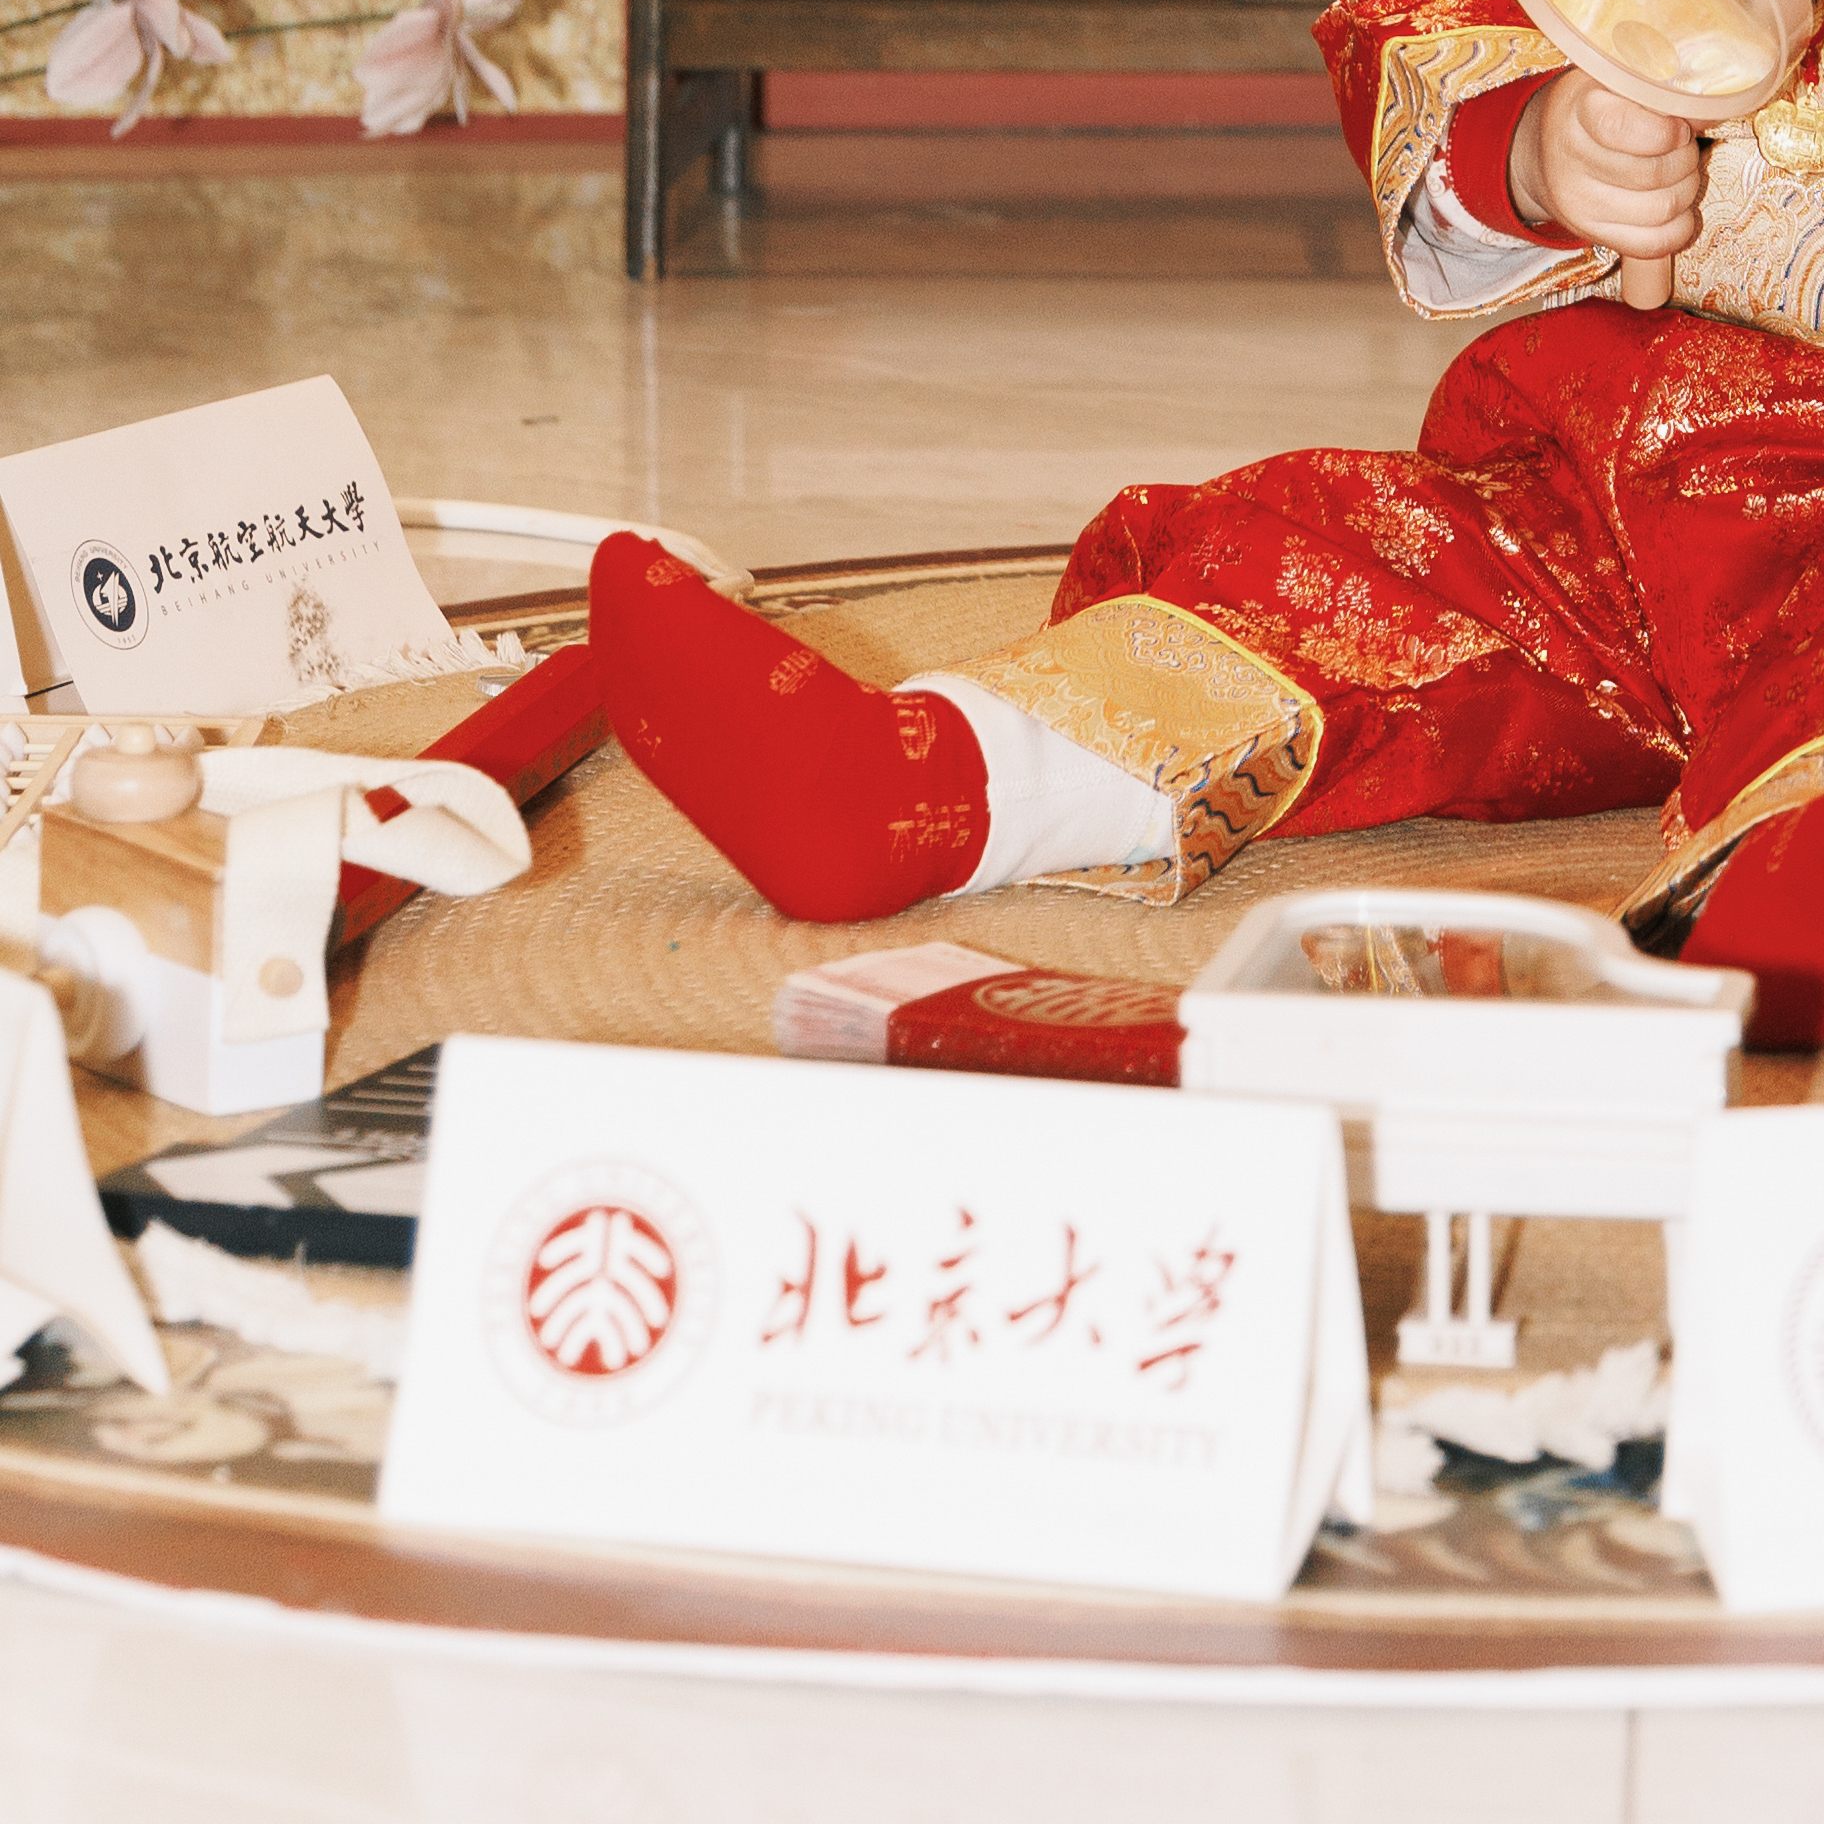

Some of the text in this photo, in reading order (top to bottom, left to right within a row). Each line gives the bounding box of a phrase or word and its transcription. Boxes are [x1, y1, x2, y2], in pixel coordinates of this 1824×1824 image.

[160, 540, 382, 617] BEIHANG UNIVERSITY
[749, 1388, 1222, 1470] PEKING UNIVERSITY
